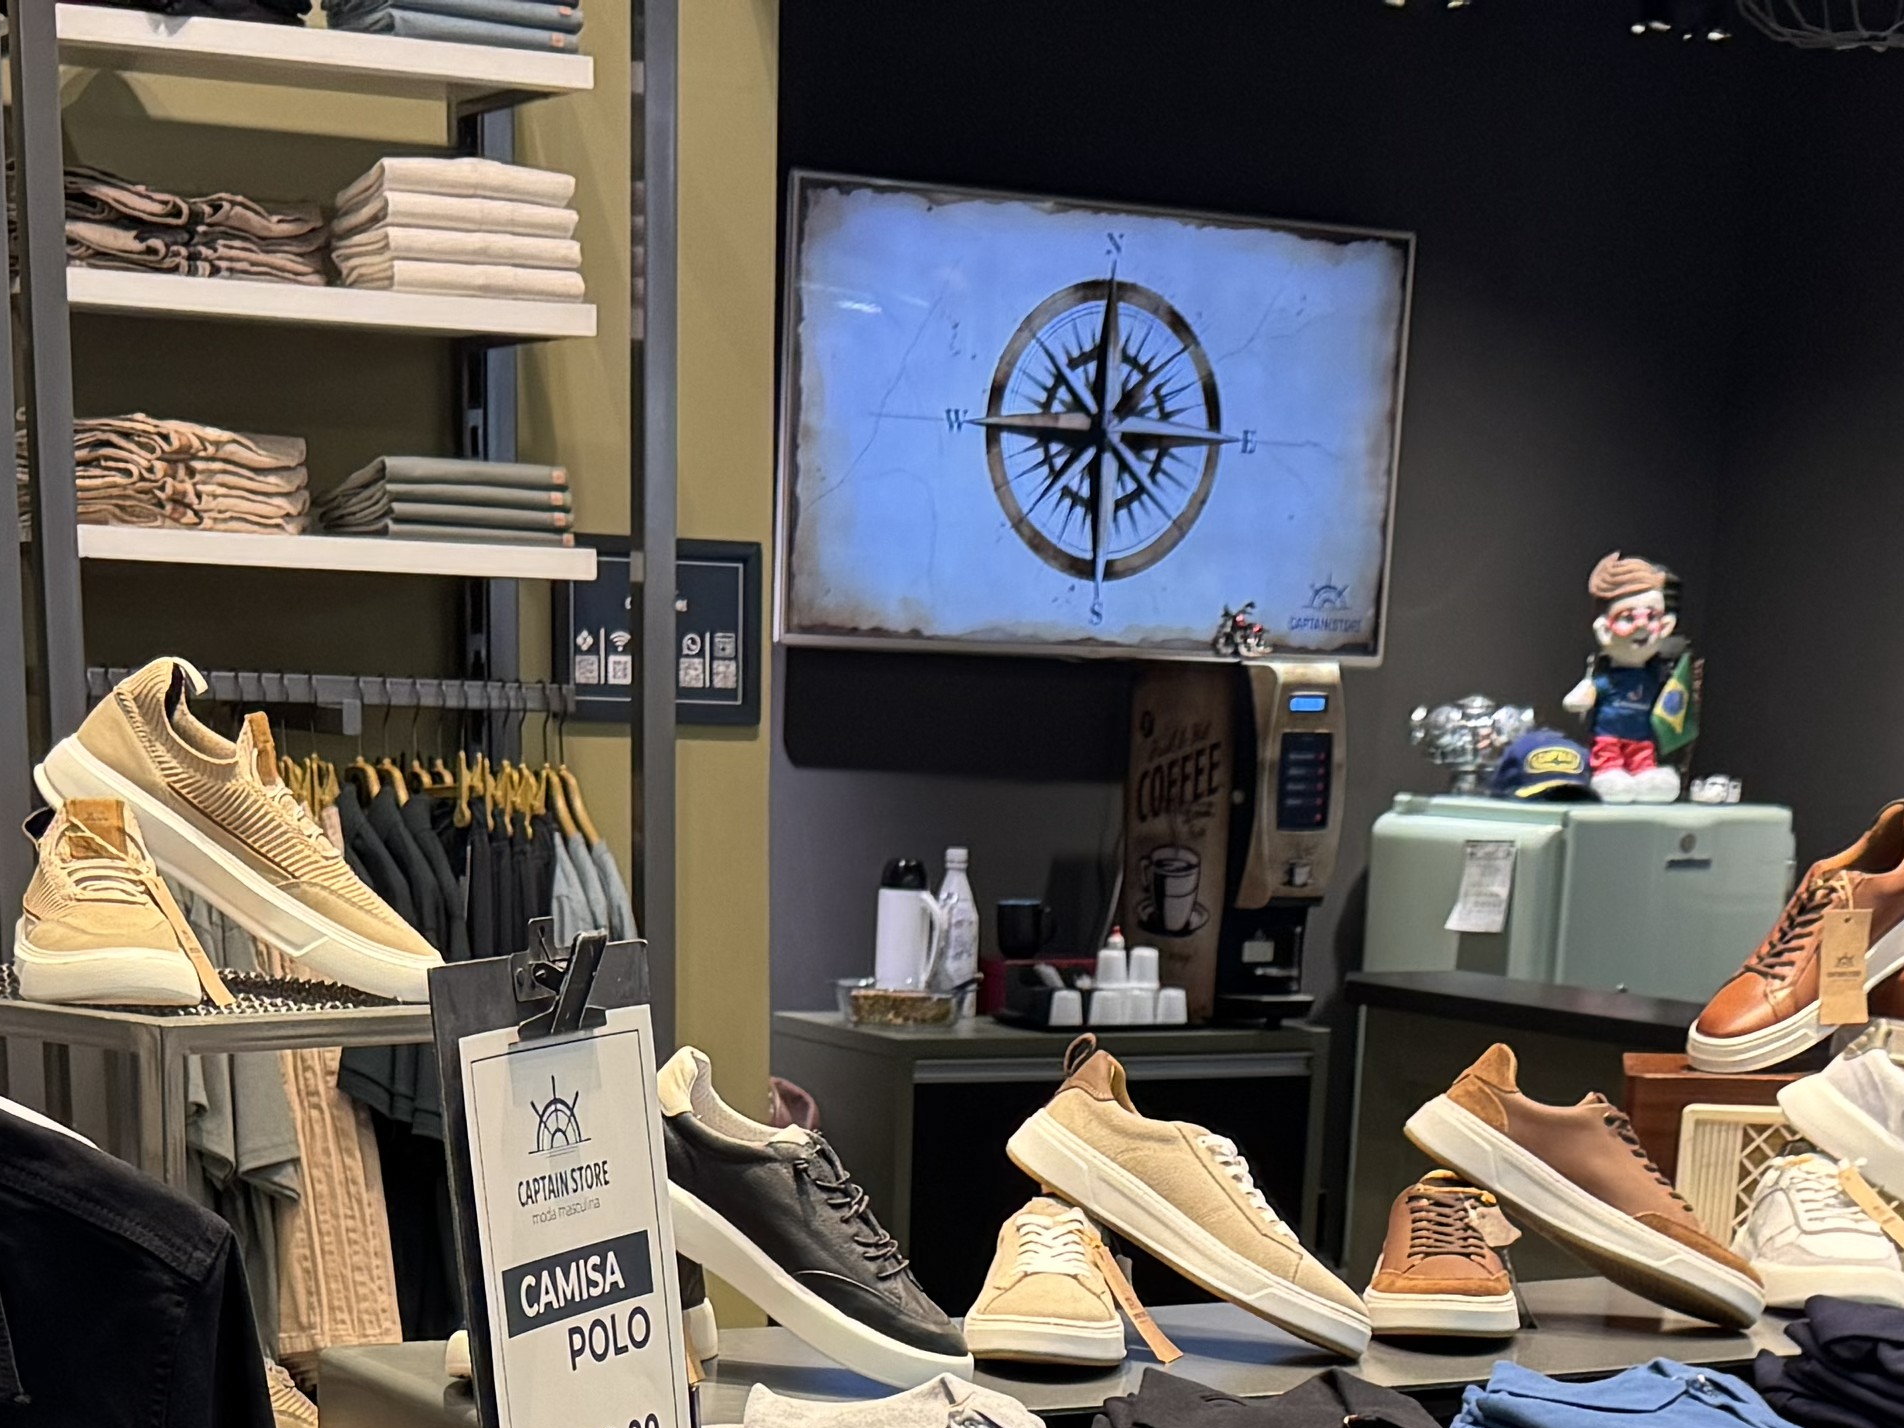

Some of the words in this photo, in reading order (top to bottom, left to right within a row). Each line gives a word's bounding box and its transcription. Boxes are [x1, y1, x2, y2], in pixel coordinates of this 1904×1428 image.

[944, 408, 970, 432] W
[1240, 430, 1257, 454] E
[1089, 603, 1104, 626] S
[1137, 740, 1222, 823] COFFEE
[517, 1171, 569, 1208] CAPTAIN
[570, 1160, 610, 1193] STORE
[531, 1208, 557, 1225] moda
[558, 1197, 601, 1218] masculina
[520, 1250, 626, 1318] CAMISA
[567, 1306, 652, 1372] POLO
